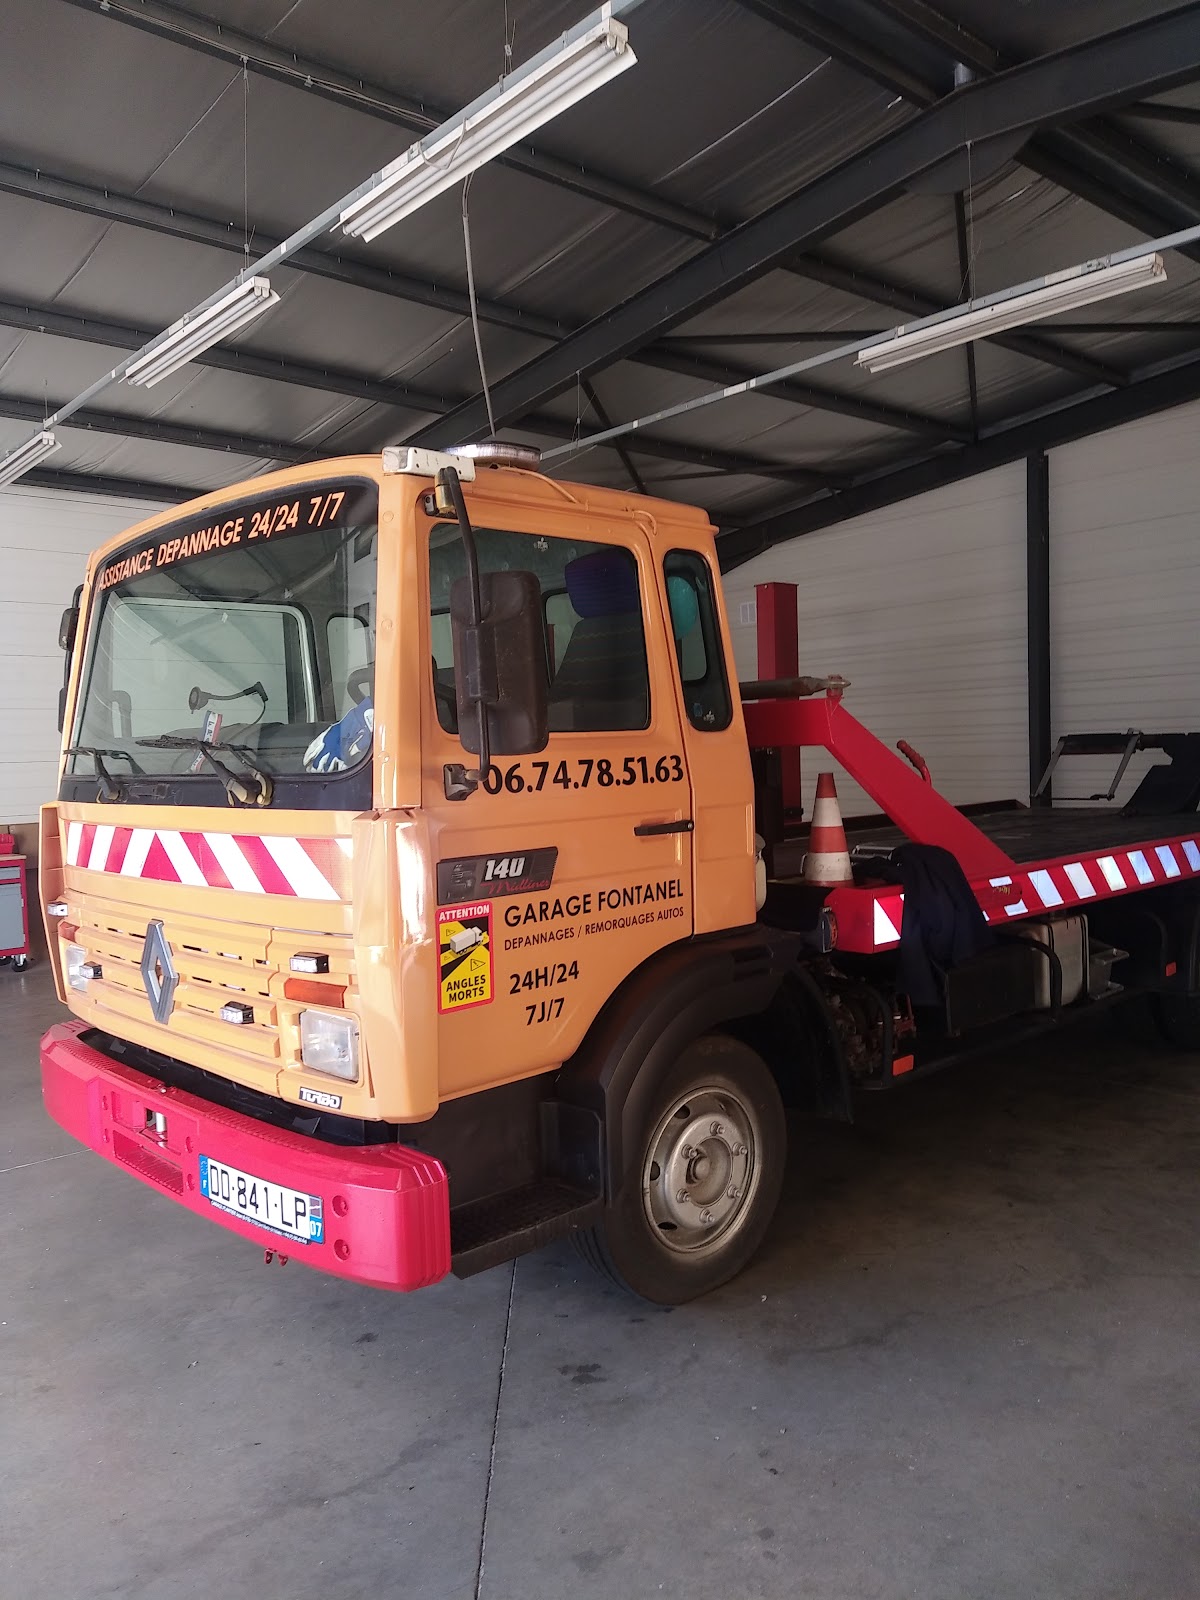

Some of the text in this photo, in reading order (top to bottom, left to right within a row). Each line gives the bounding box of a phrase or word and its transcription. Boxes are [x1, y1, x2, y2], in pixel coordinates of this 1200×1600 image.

[97, 492, 345, 592] ASSISTANCE DEPANNAGE 24/24 7/7
[483, 755, 684, 795] 06.74.78.51.63
[485, 857, 526, 881] 140
[439, 904, 490, 922] ATTENTION
[504, 879, 684, 928] GARAGE FONTANEL
[504, 927, 575, 951] DEPANNAGES
[585, 912, 655, 936] REMORQUAGES
[657, 906, 684, 921] AUTOS
[446, 974, 486, 992] ANGLES
[509, 960, 579, 995] 24H/24
[448, 986, 485, 1003] MORTS
[525, 997, 565, 1026] 7J/7
[300, 1087, 341, 1109] TURBO
[309, 1220, 322, 1238] 07
